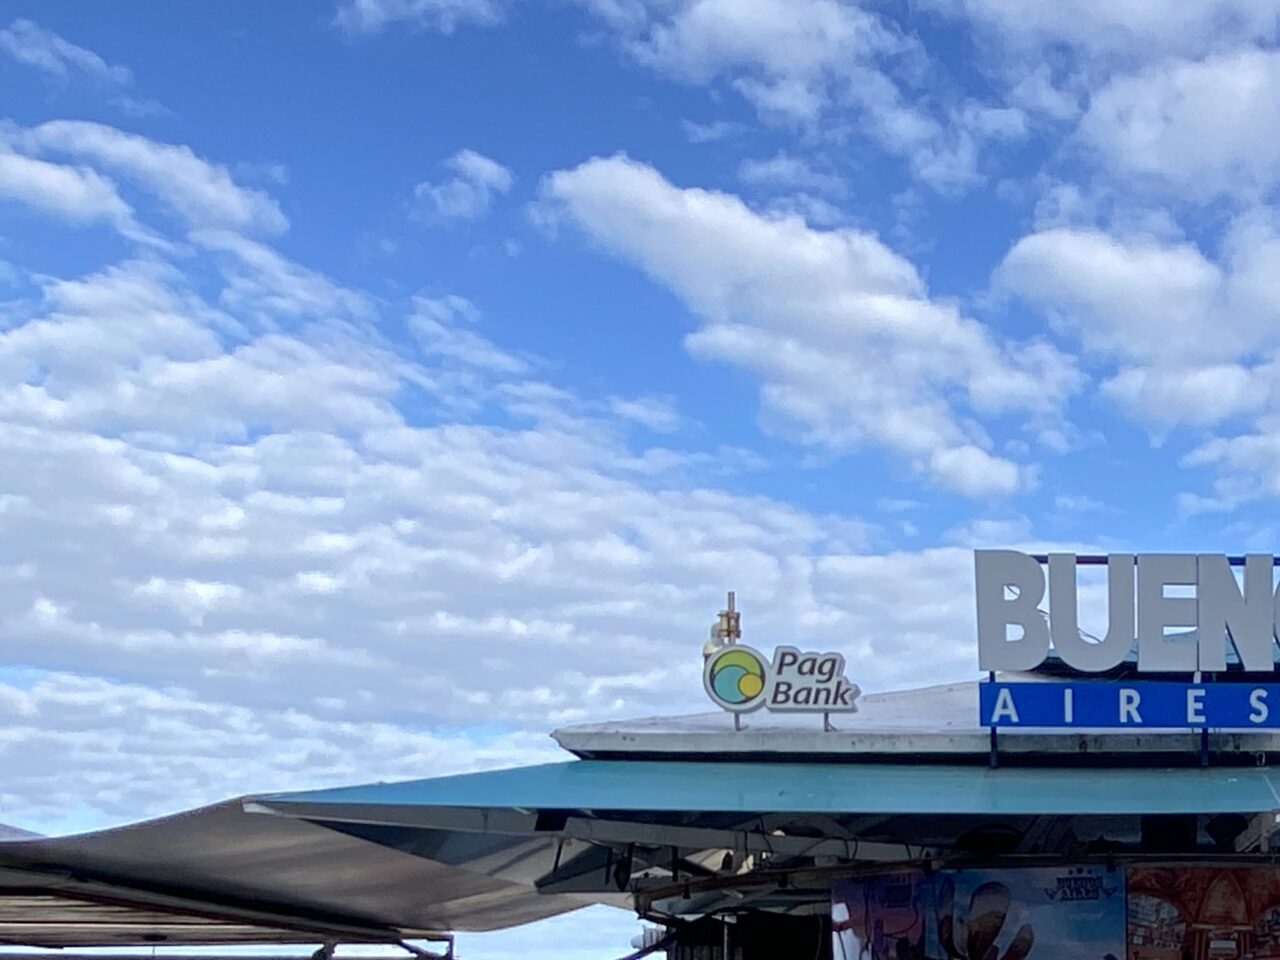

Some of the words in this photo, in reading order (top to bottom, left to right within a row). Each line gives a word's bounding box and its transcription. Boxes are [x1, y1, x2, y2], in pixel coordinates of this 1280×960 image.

[776, 652, 837, 683] Pag
[771, 681, 852, 705] Bank
[991, 688, 1270, 724] AIRES
